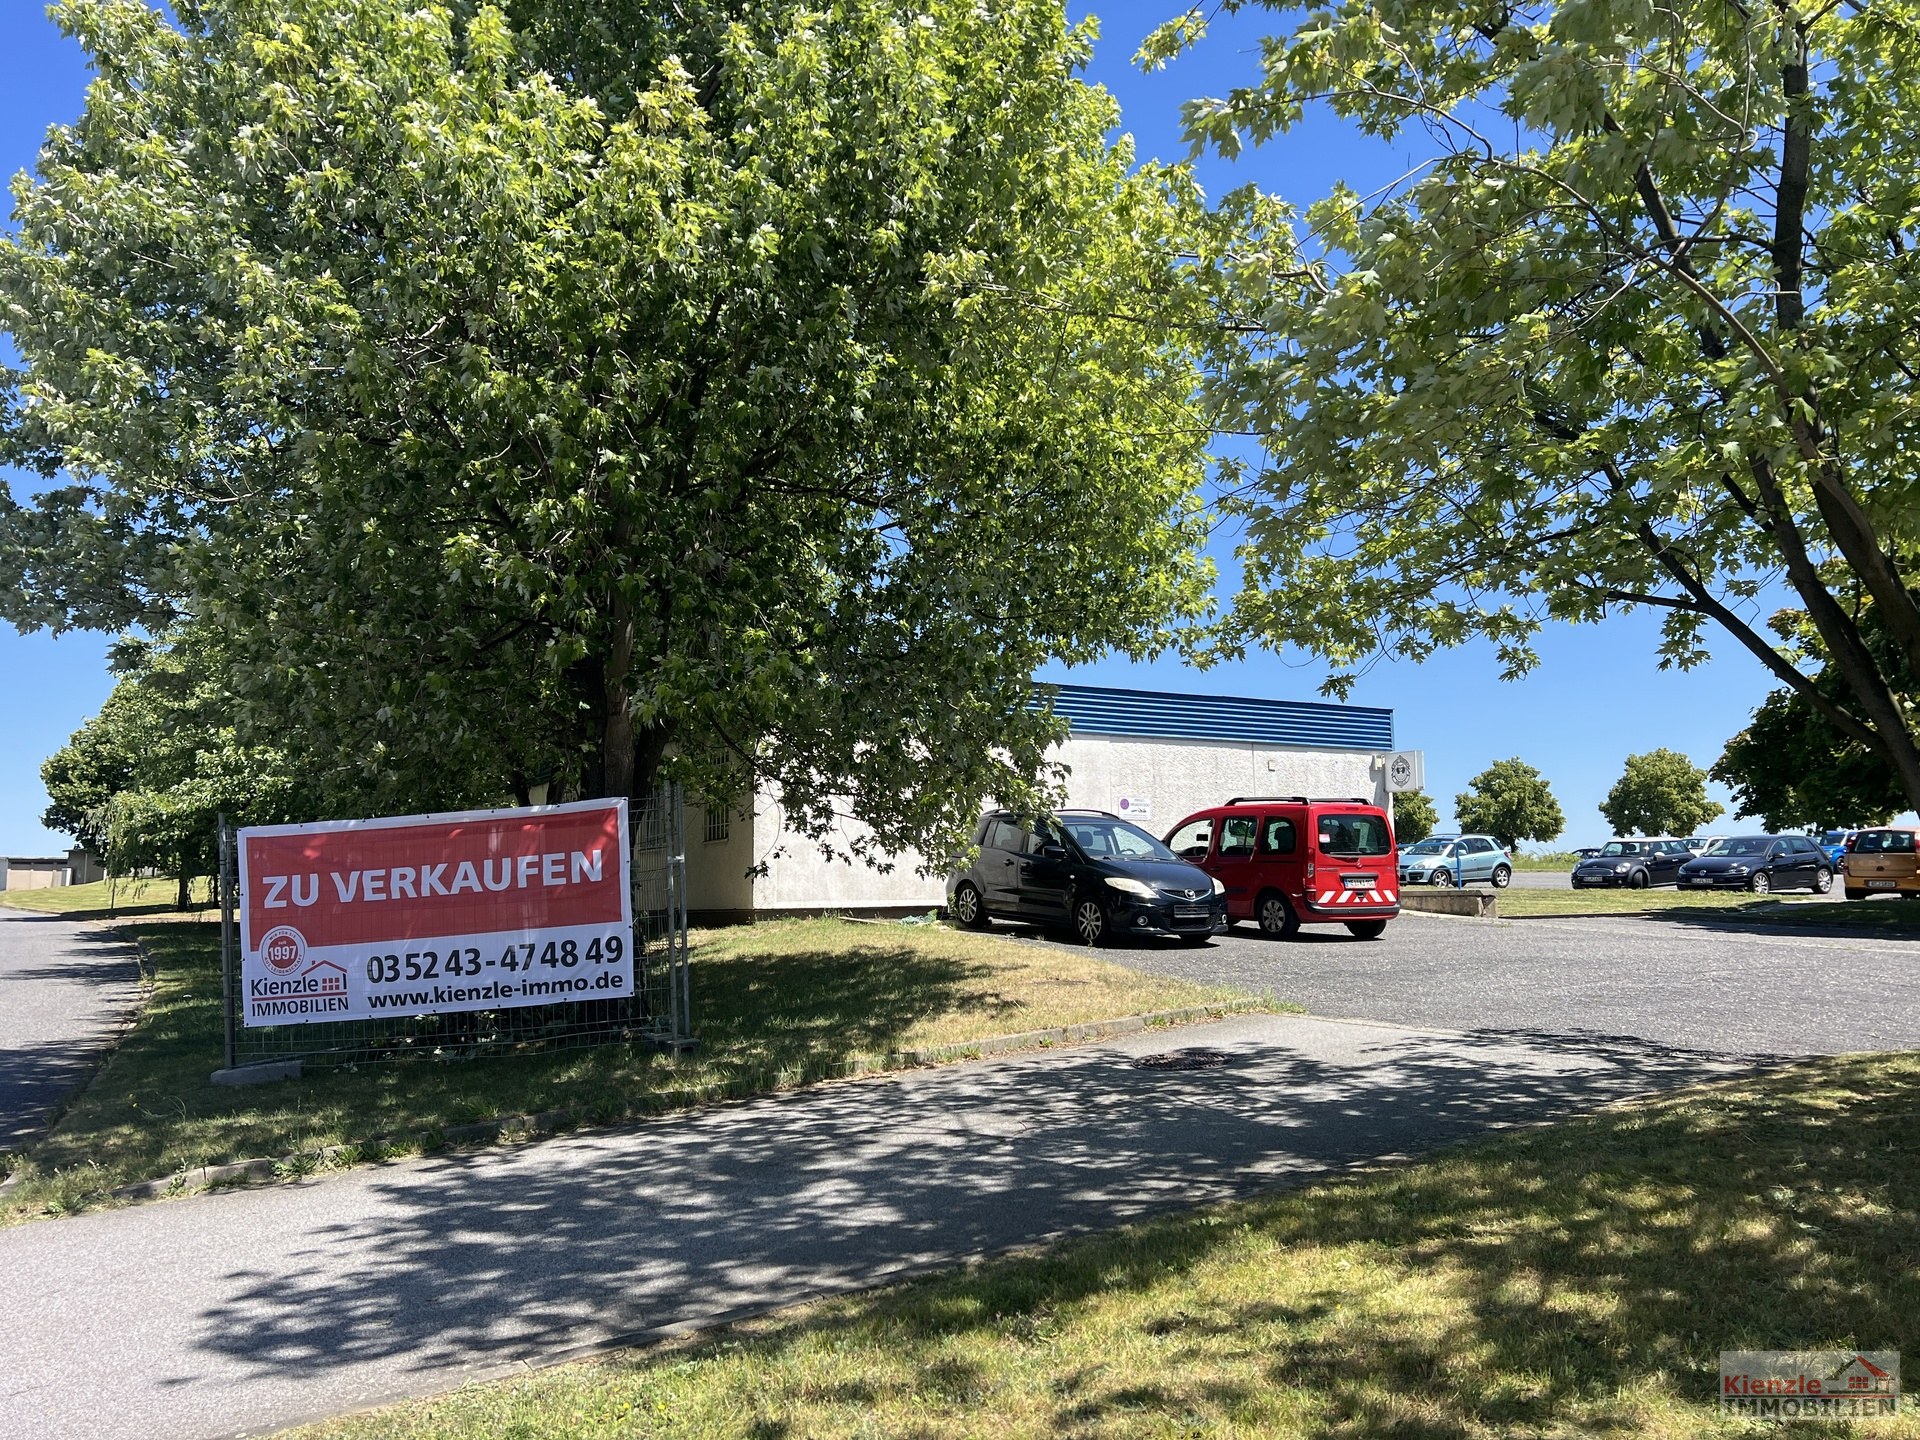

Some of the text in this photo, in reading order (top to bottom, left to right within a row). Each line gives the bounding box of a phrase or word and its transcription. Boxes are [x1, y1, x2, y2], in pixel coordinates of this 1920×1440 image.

[262, 849, 603, 909] ZU VERKAUFEN
[268, 945, 297, 961] 1997
[250, 977, 319, 997] Kienzle
[367, 971, 623, 1009] www.kienzle-immo.de
[252, 997, 349, 1016] IMMOBILIEN
